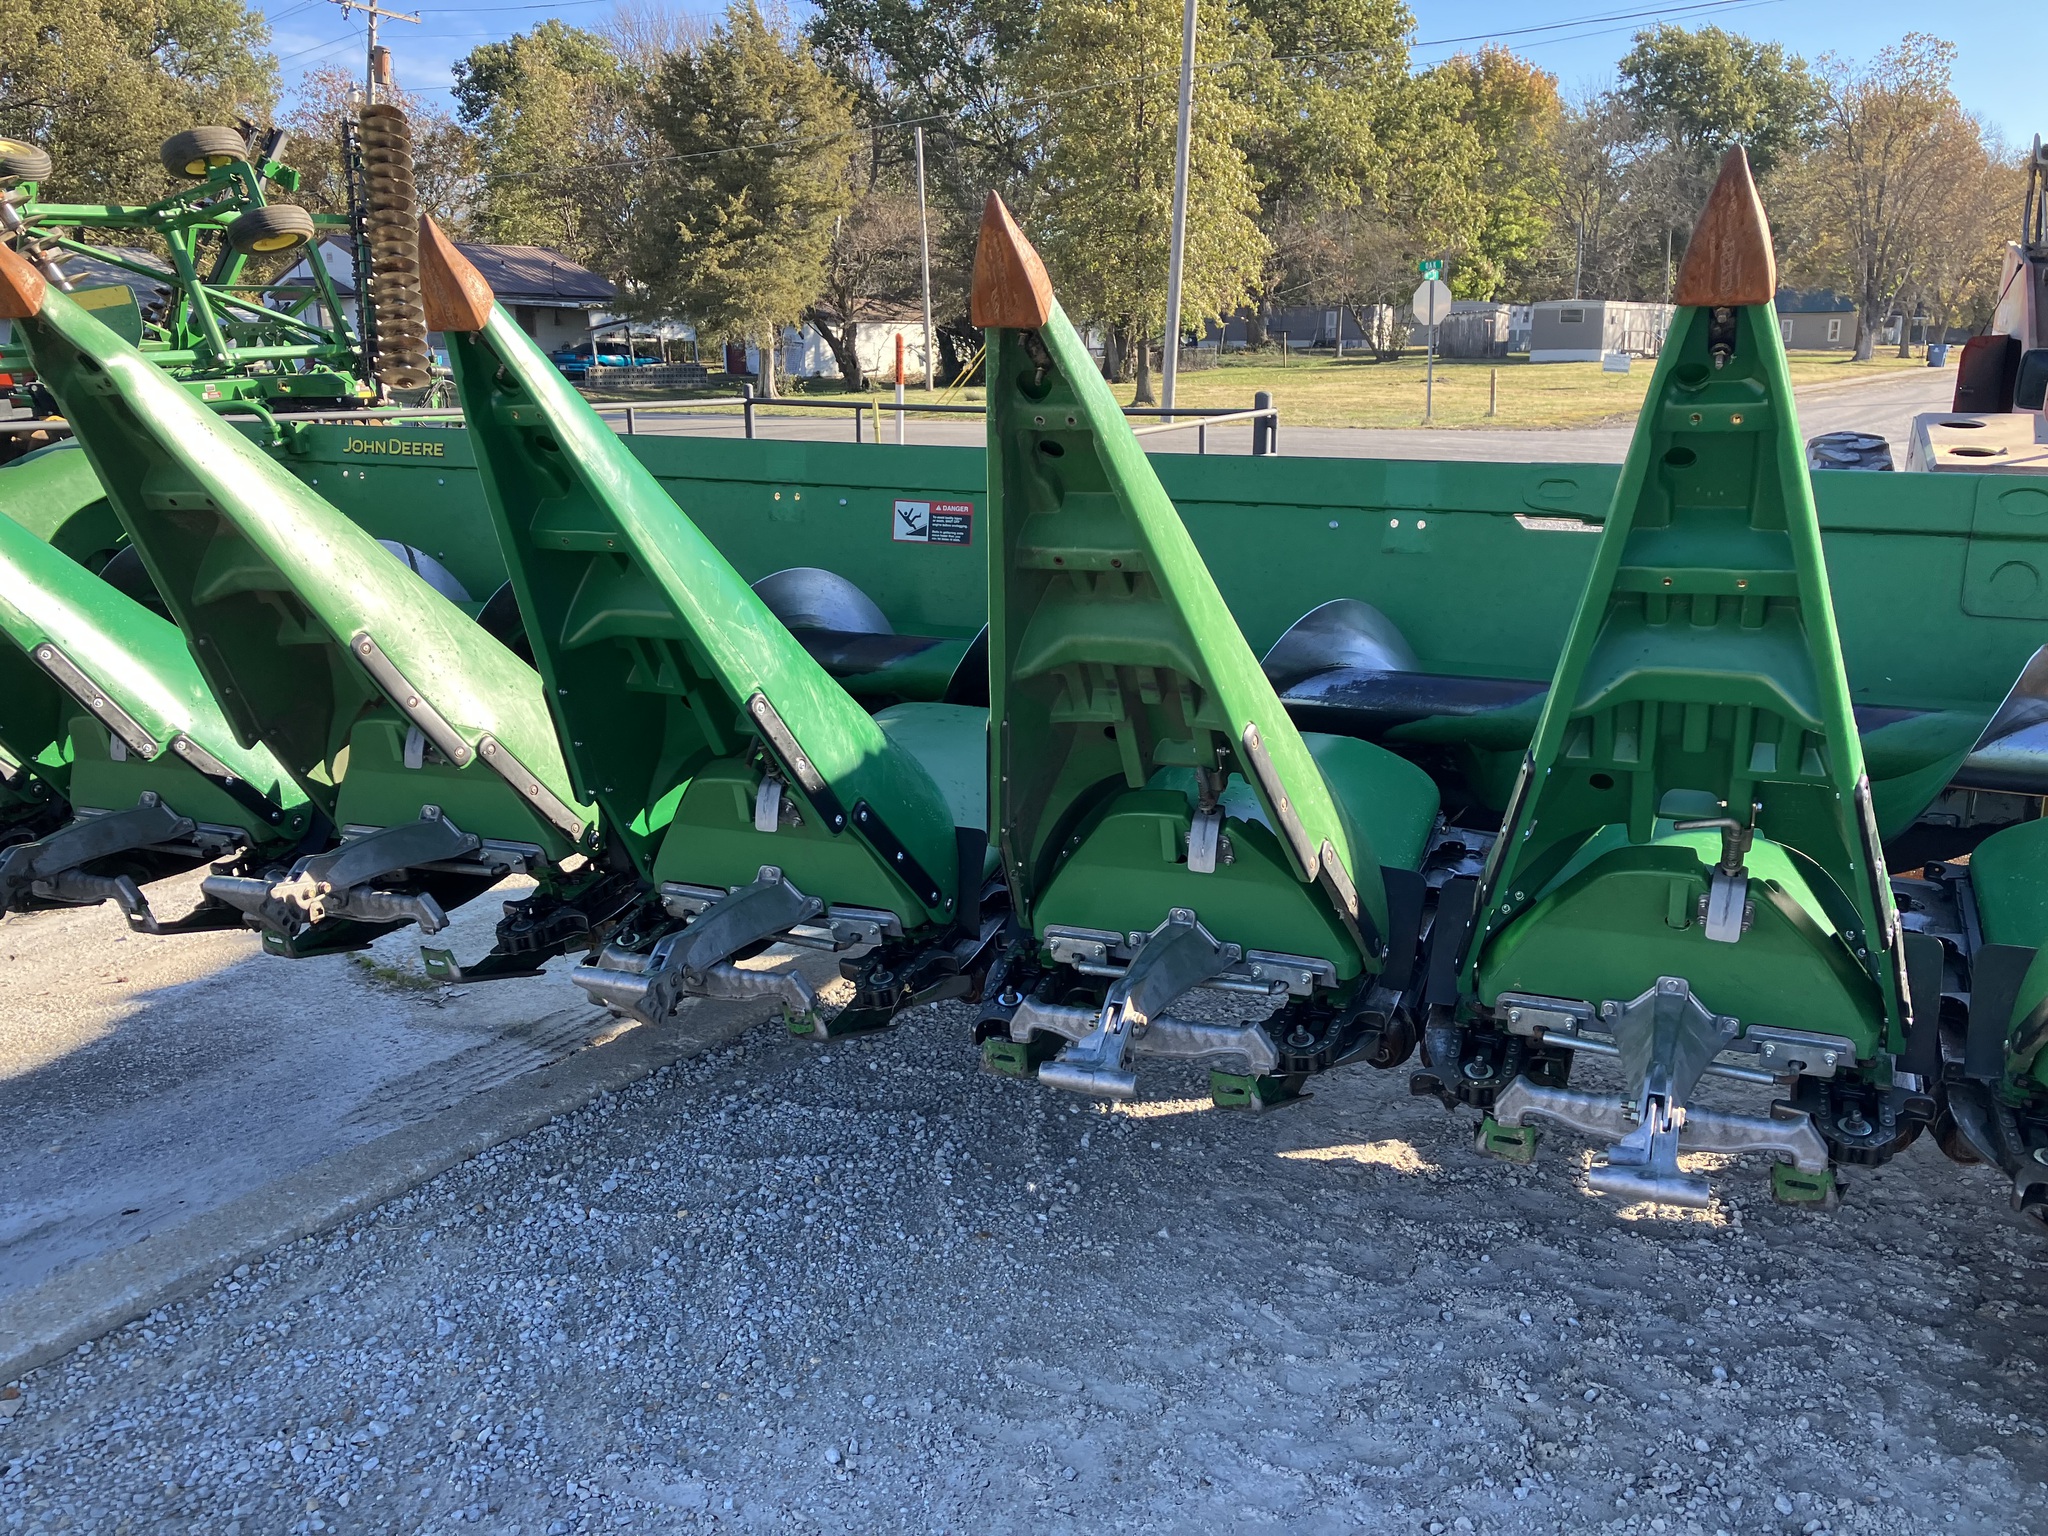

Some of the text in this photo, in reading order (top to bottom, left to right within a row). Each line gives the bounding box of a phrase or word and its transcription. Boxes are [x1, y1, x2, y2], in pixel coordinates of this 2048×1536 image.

[342, 436, 444, 457] JOHN DEERE
[942, 504, 969, 512] DANGER
